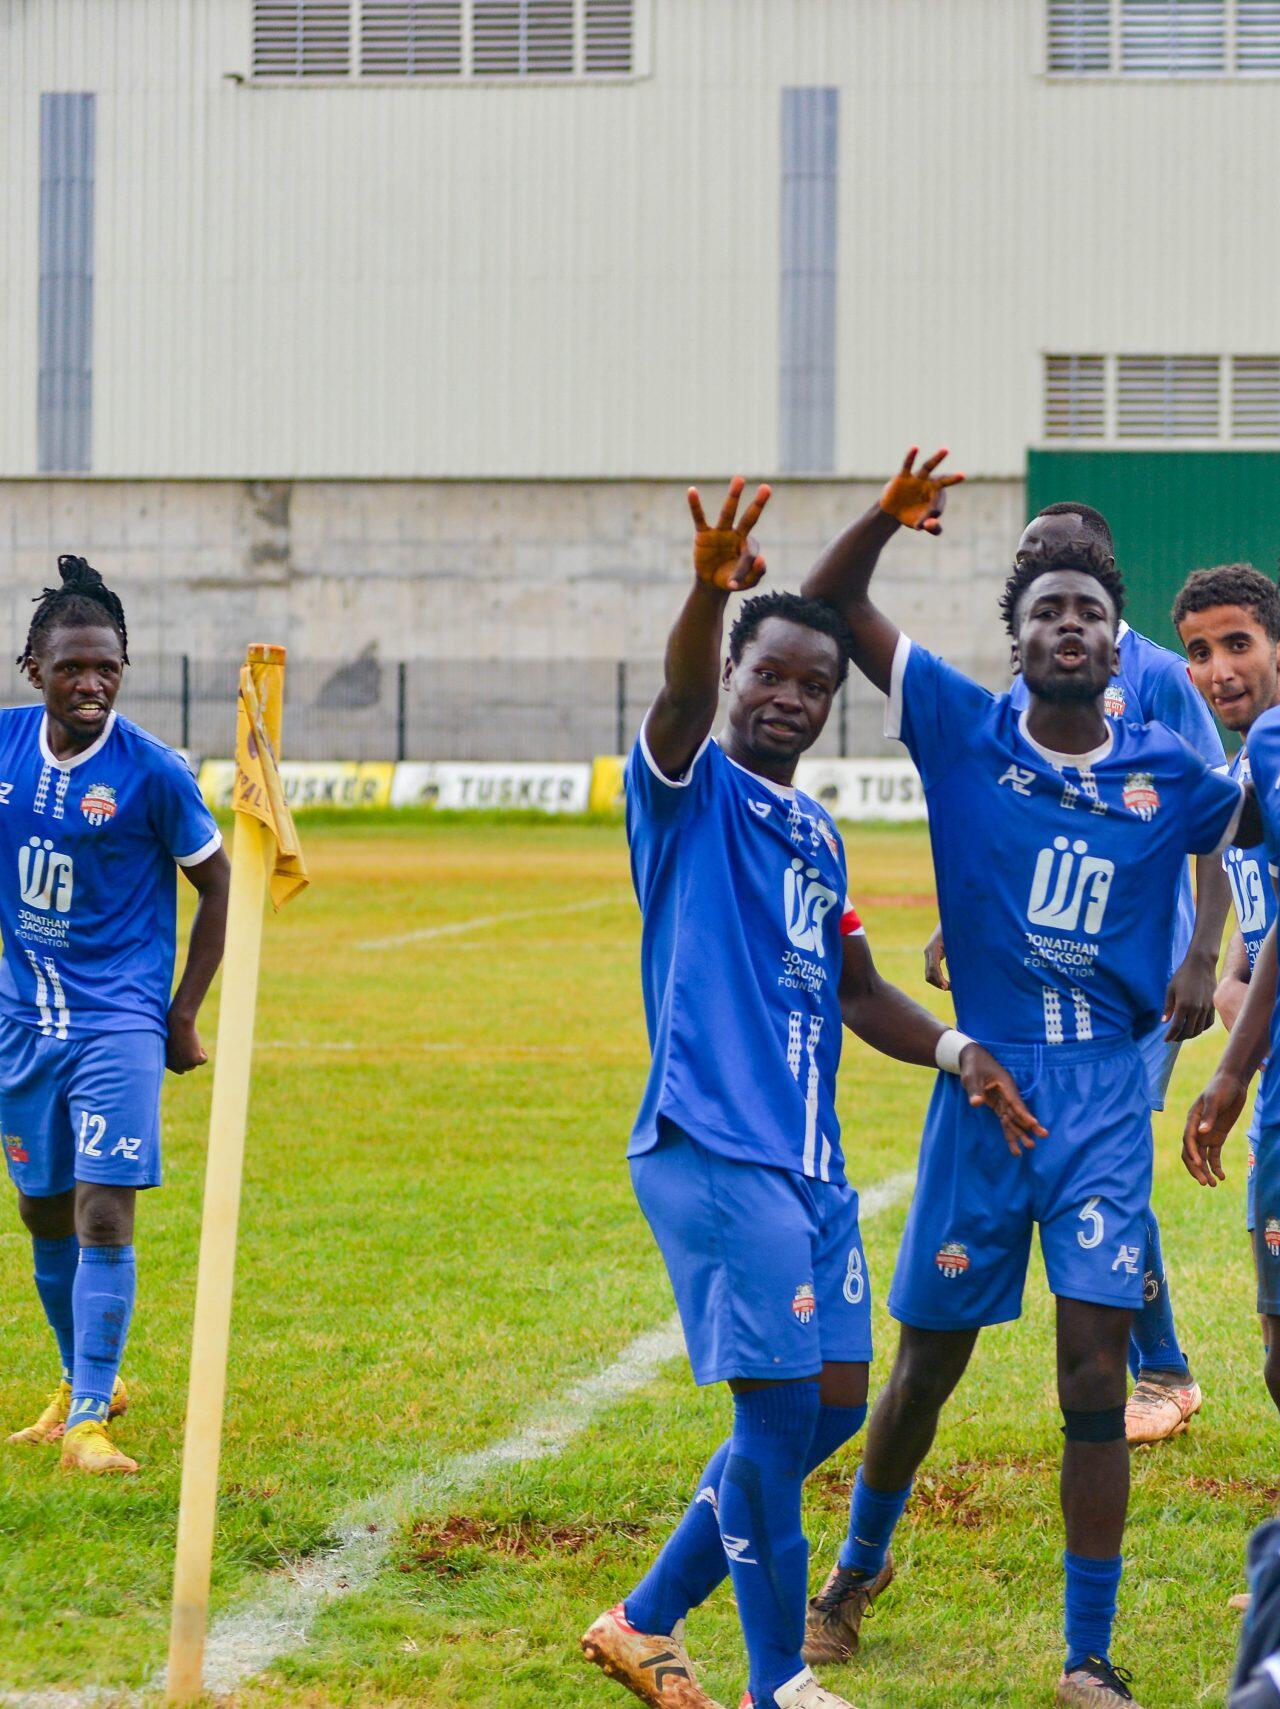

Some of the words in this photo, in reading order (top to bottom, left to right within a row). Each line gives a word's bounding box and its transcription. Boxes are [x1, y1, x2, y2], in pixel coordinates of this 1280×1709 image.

[284, 777, 378, 802] USKER
[460, 777, 574, 803] TUSKER
[859, 776, 926, 802] TUS
[18, 909, 70, 929] JONATHAN
[20, 919, 66, 939] JACKSON
[14, 929, 70, 949] FOUNDATION
[1025, 932, 1099, 956] JONATHAN
[79, 1110, 107, 1157] 12
[842, 1246, 865, 1304] 8
